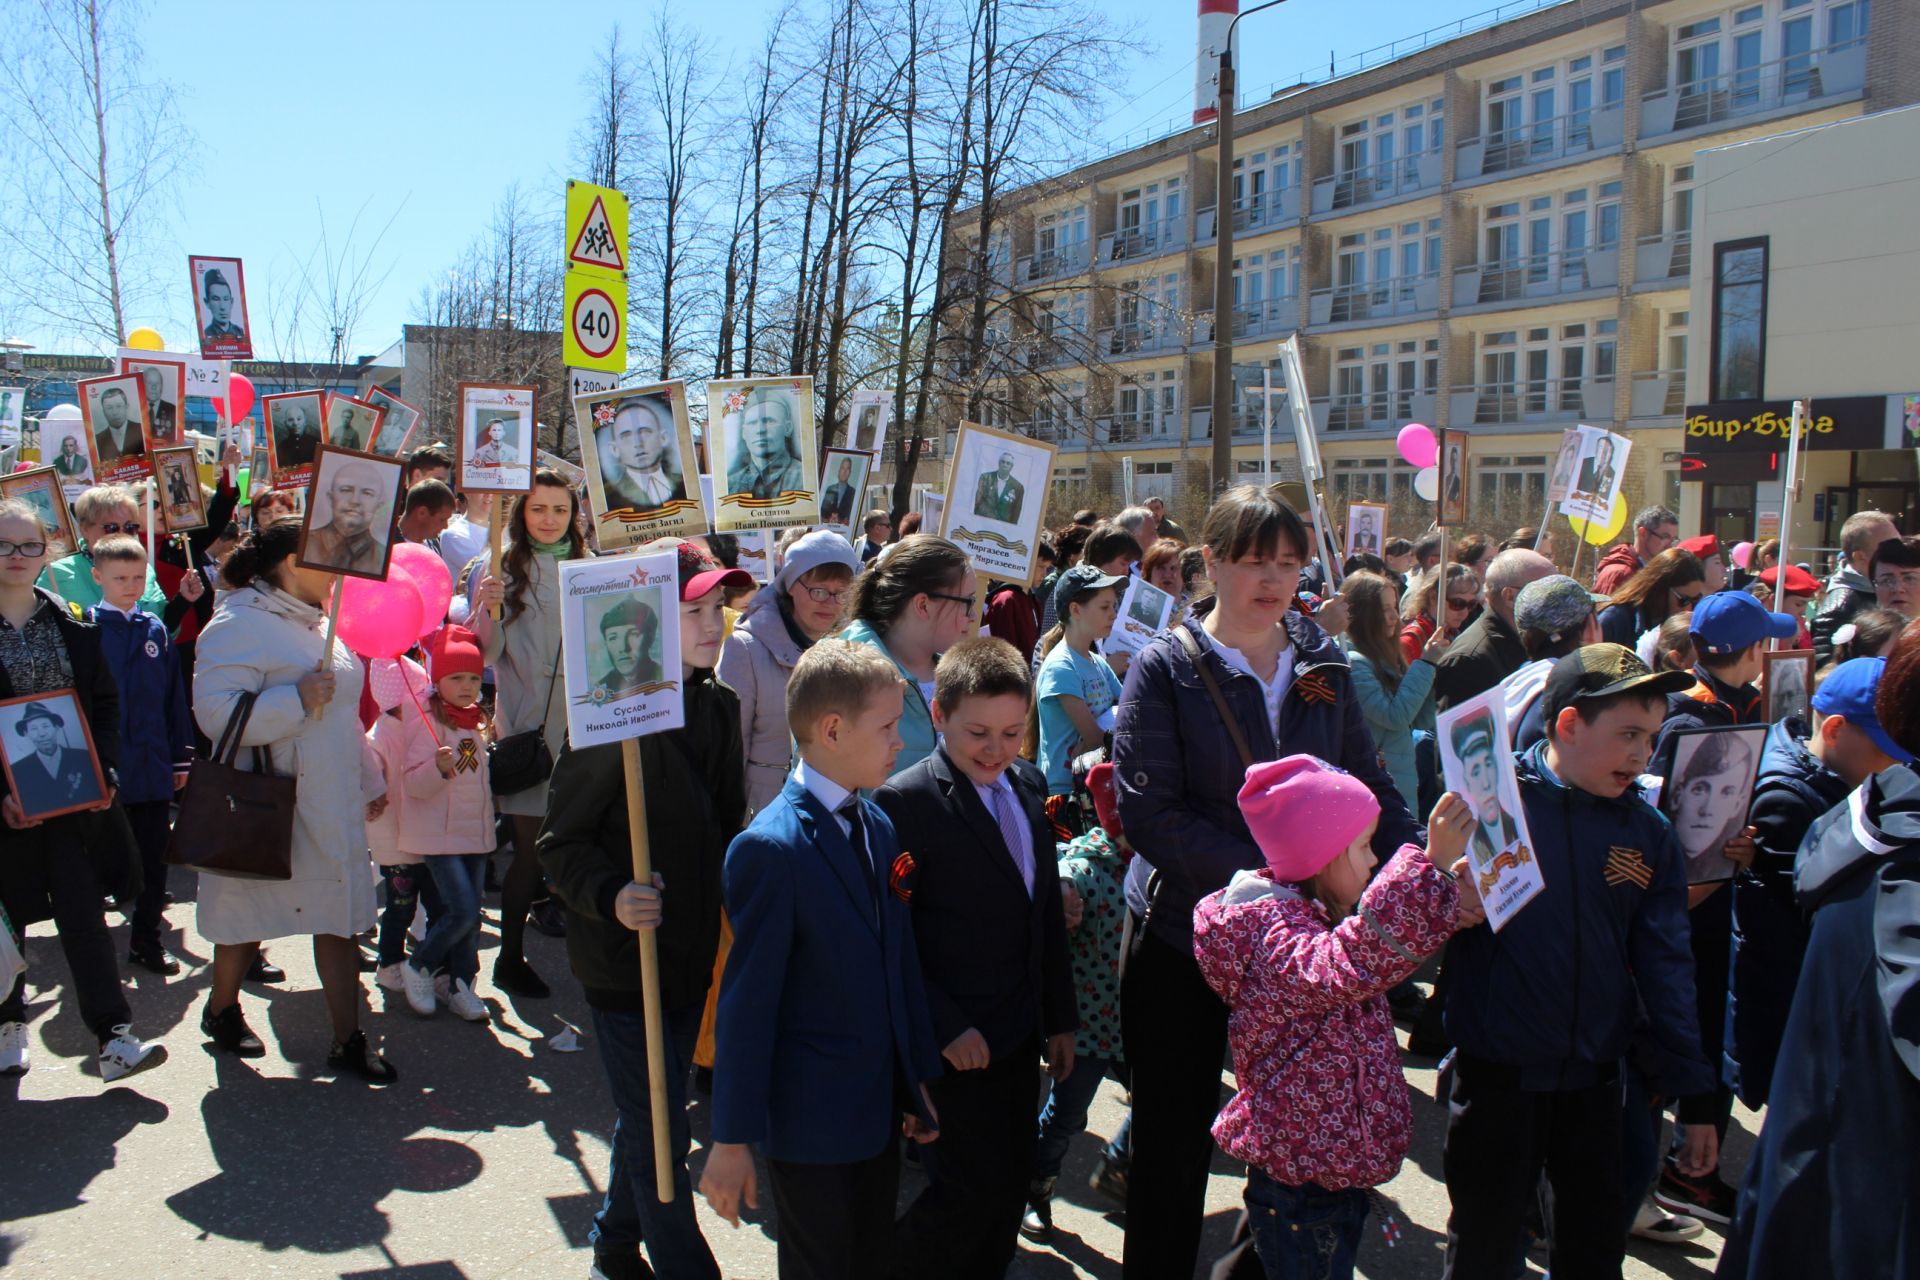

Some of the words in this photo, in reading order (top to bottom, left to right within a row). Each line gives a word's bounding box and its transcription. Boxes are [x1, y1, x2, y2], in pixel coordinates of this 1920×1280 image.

[581, 309, 610, 338] 40
[211, 370, 220, 383] 2
[583, 380, 607, 392] 200м
[290, 472, 313, 481] БАКАЕ
[750, 509, 791, 518] Солдатов
[625, 522, 657, 533] Галеев
[735, 522, 758, 530] Иван
[967, 541, 1010, 558] Миргазеев
[649, 574, 672, 585] полк
[613, 703, 647, 716] Суслов
[586, 718, 628, 733] Николай
[630, 710, 671, 725] Иванович
